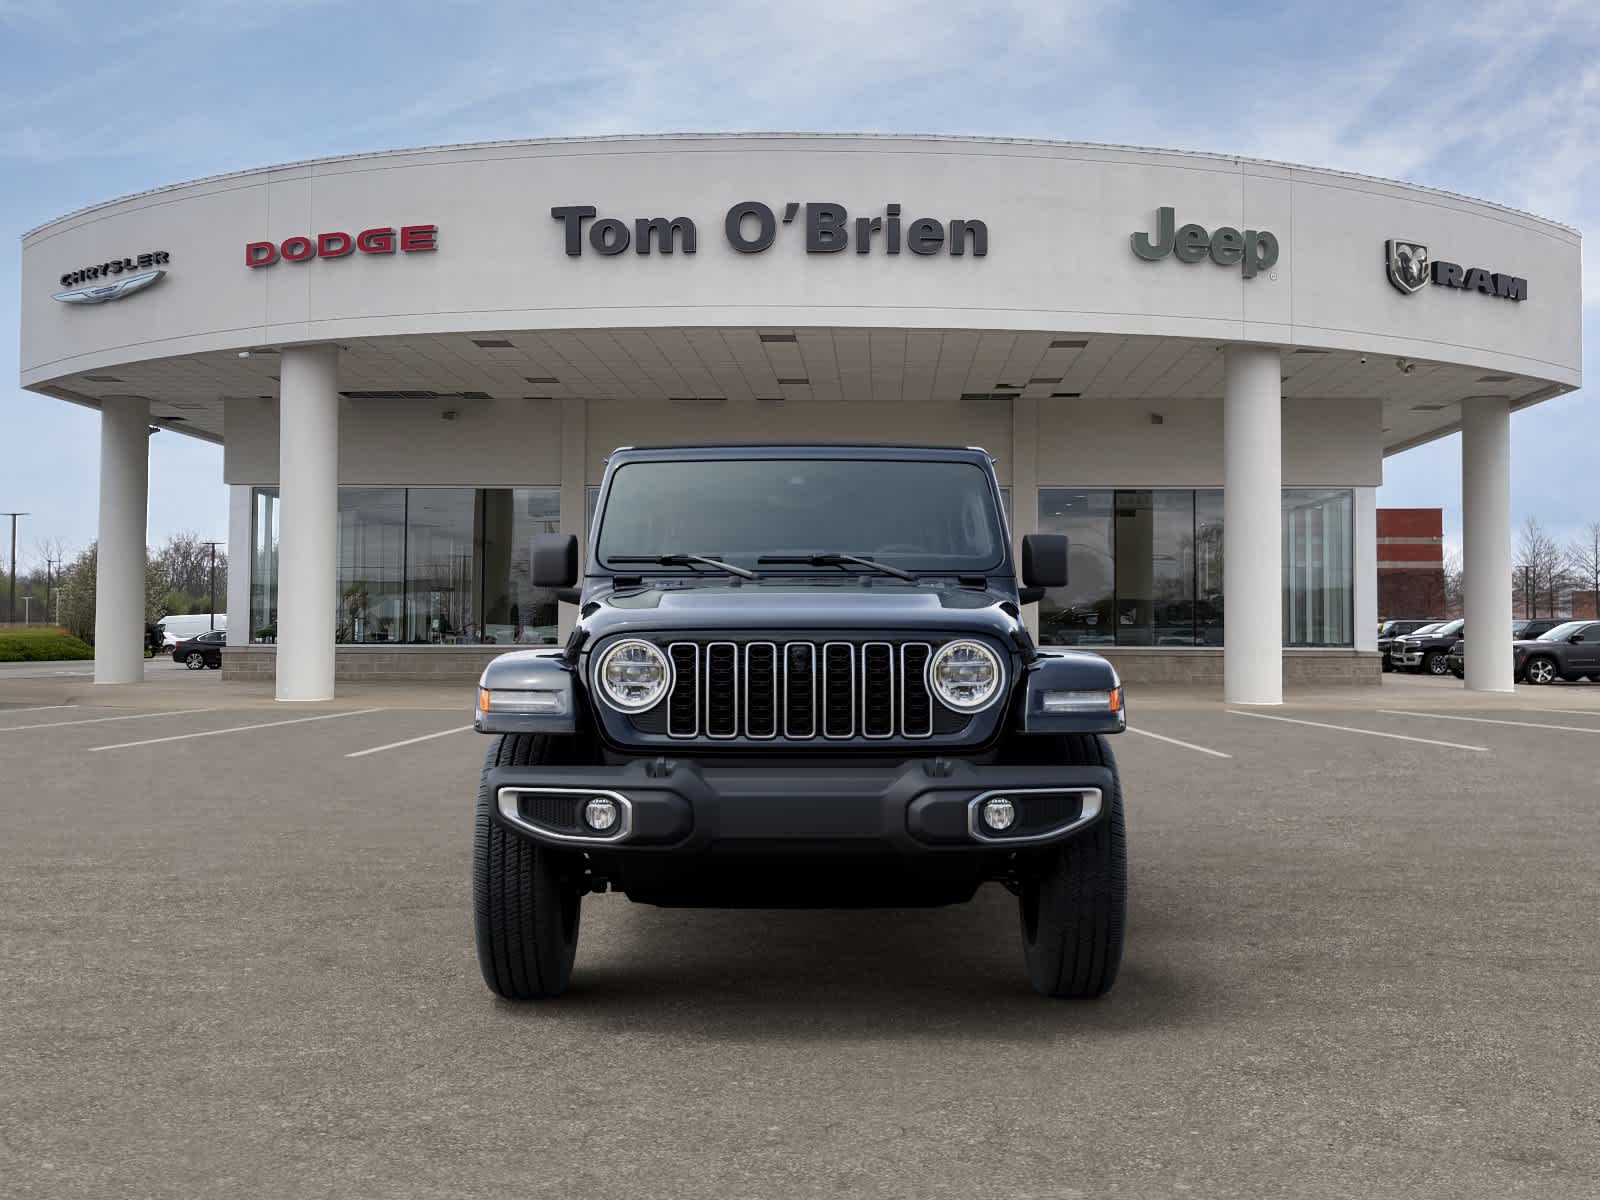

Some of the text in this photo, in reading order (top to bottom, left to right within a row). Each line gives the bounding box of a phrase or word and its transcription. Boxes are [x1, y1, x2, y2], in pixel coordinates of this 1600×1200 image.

[245, 224, 438, 269] DODGE
[551, 200, 988, 257] Tom O'Brien
[1130, 206, 1279, 279] Jeep
[60, 249, 170, 287] CHRYSLER
[1431, 260, 1528, 301] RAM
